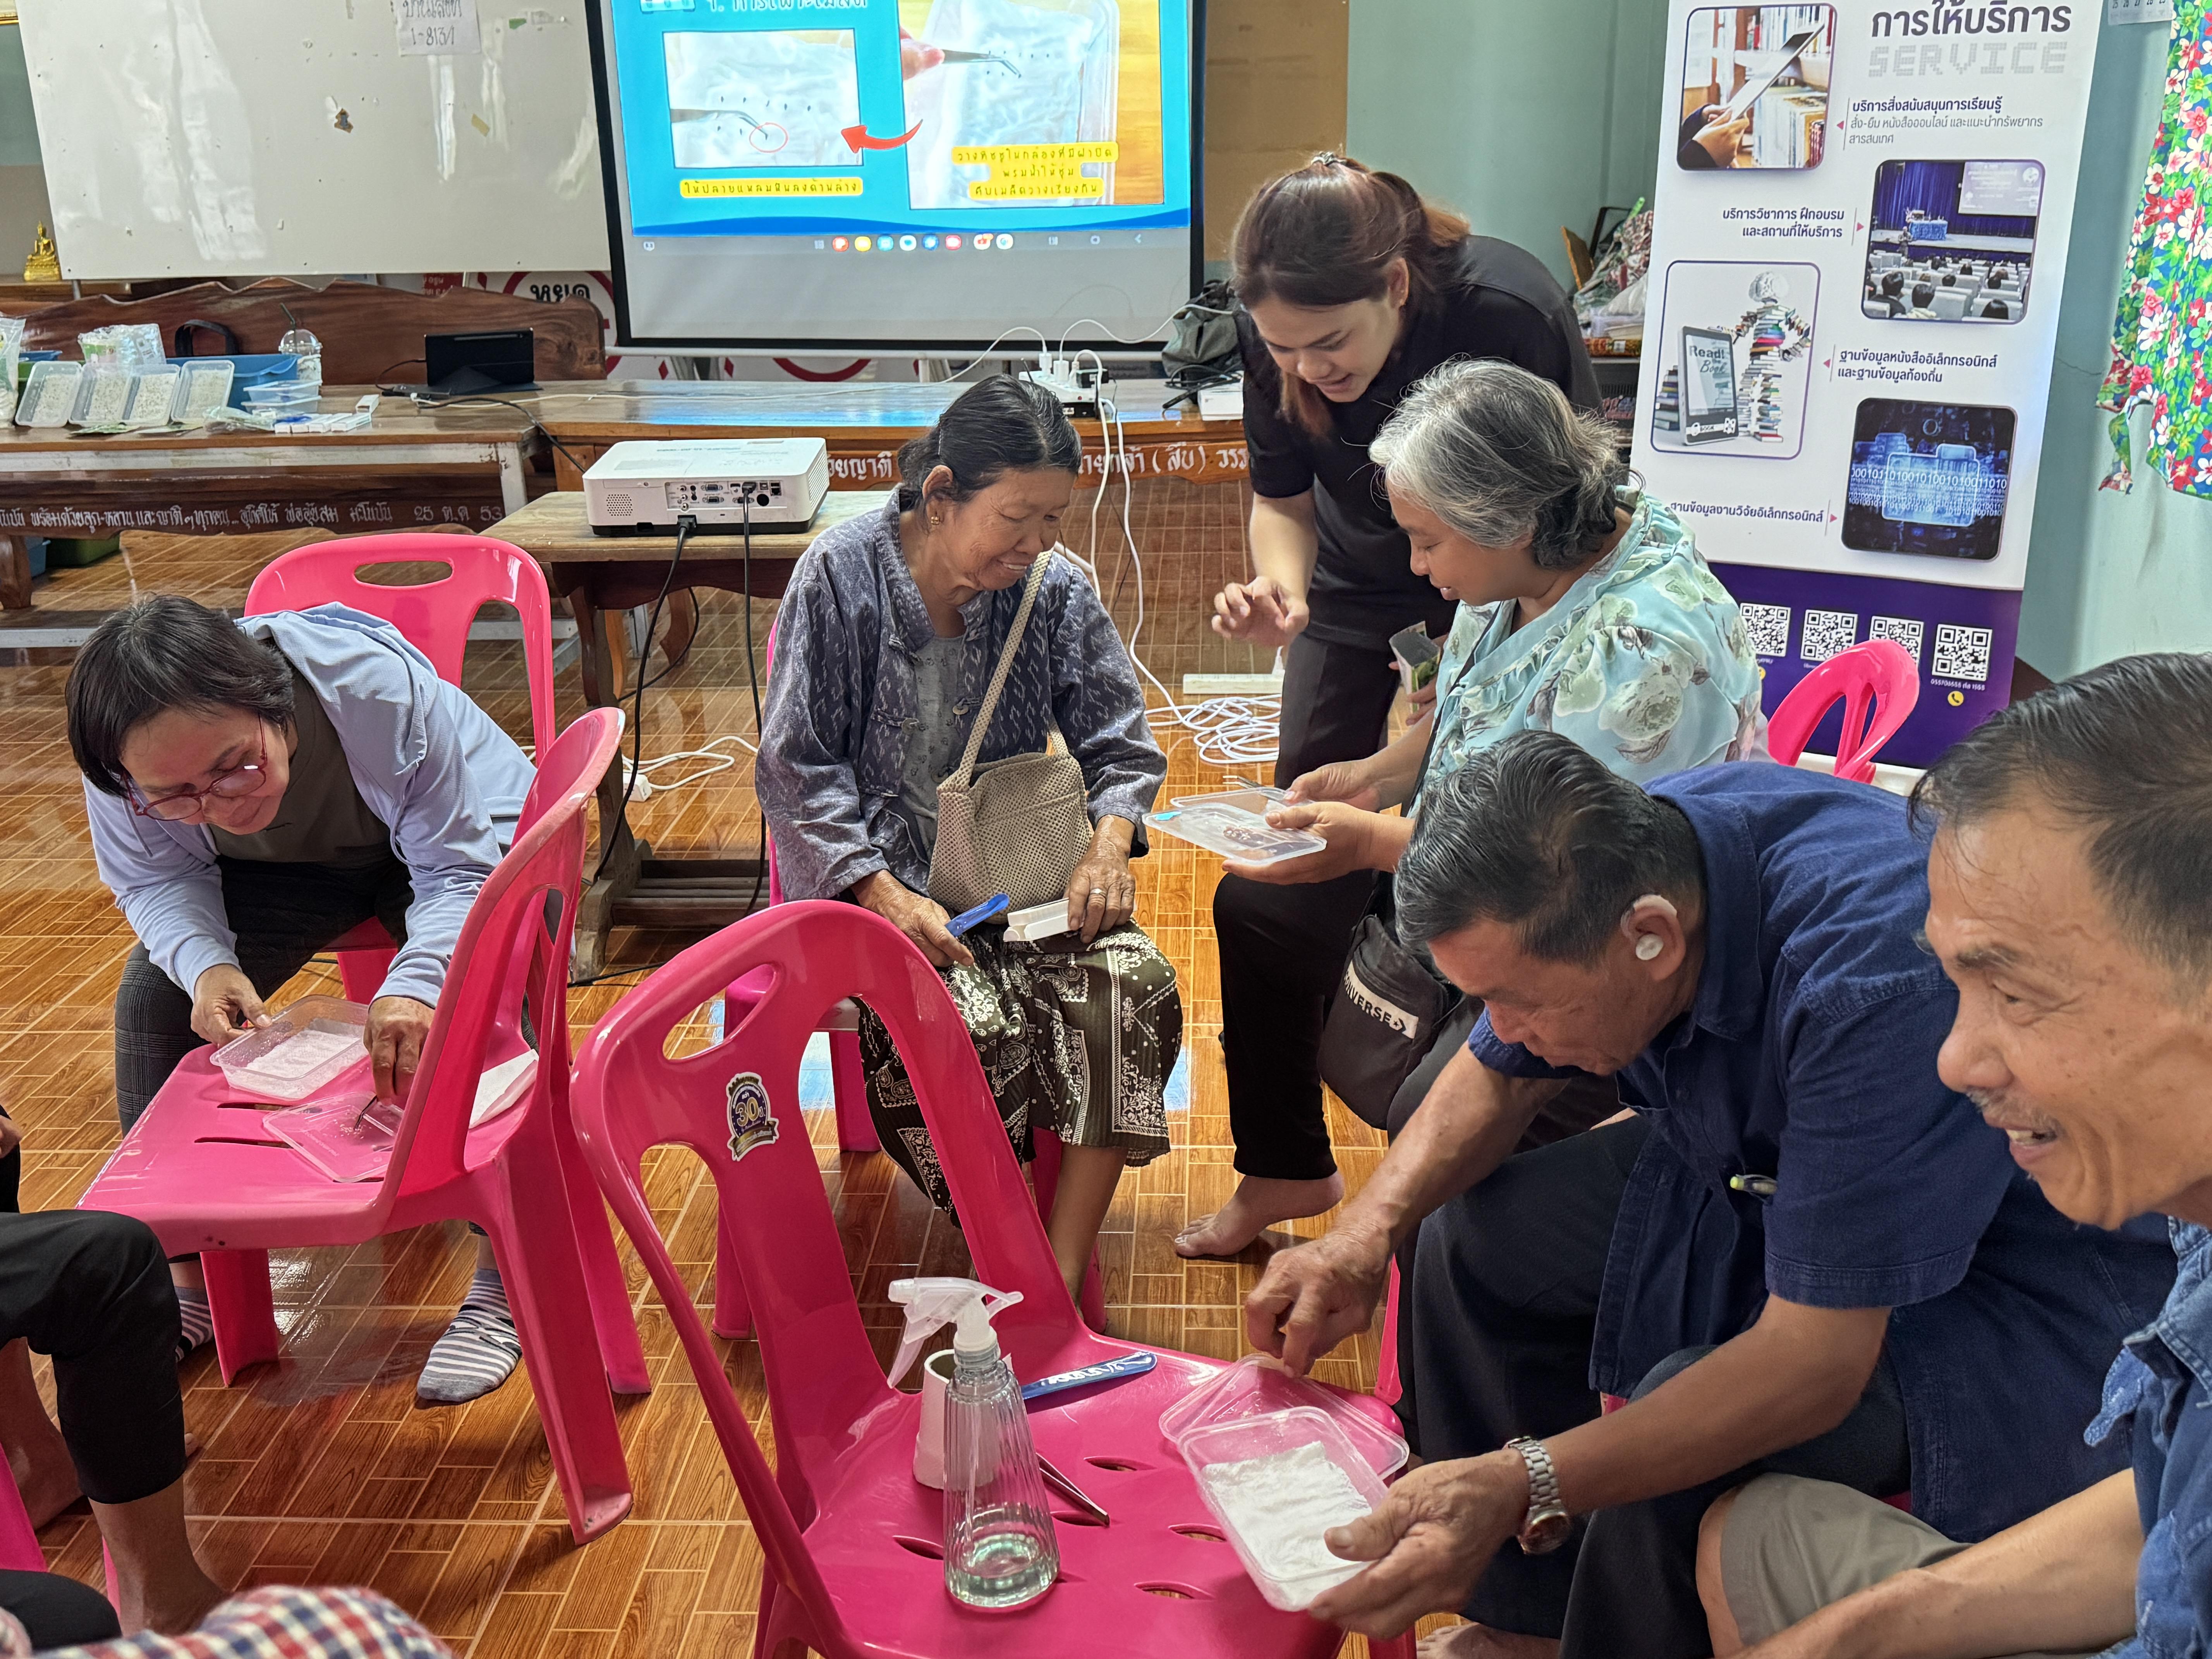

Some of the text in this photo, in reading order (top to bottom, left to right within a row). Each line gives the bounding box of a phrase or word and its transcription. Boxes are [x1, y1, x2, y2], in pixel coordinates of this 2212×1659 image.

[1869, 41, 2068, 77] SERVICE
[1853, 96, 2002, 113] บริการสิ่งสนับสนุนการเรียนรู้
[1849, 134, 1894, 144] สารสนเทศ
[1723, 206, 1844, 220] บริการวิชาการ ฝึกอบรม
[1743, 223, 1843, 238] และสถานที่ให้บริการ
[1839, 349, 1999, 368] ฐานข้อมูลหนังสืออิเล็กทรอนิกส์
[1838, 366, 1942, 383] และฐานข้อมูลท้องถิ่น
[414, 506, 434, 521] 25
[480, 506, 503, 521] 53
